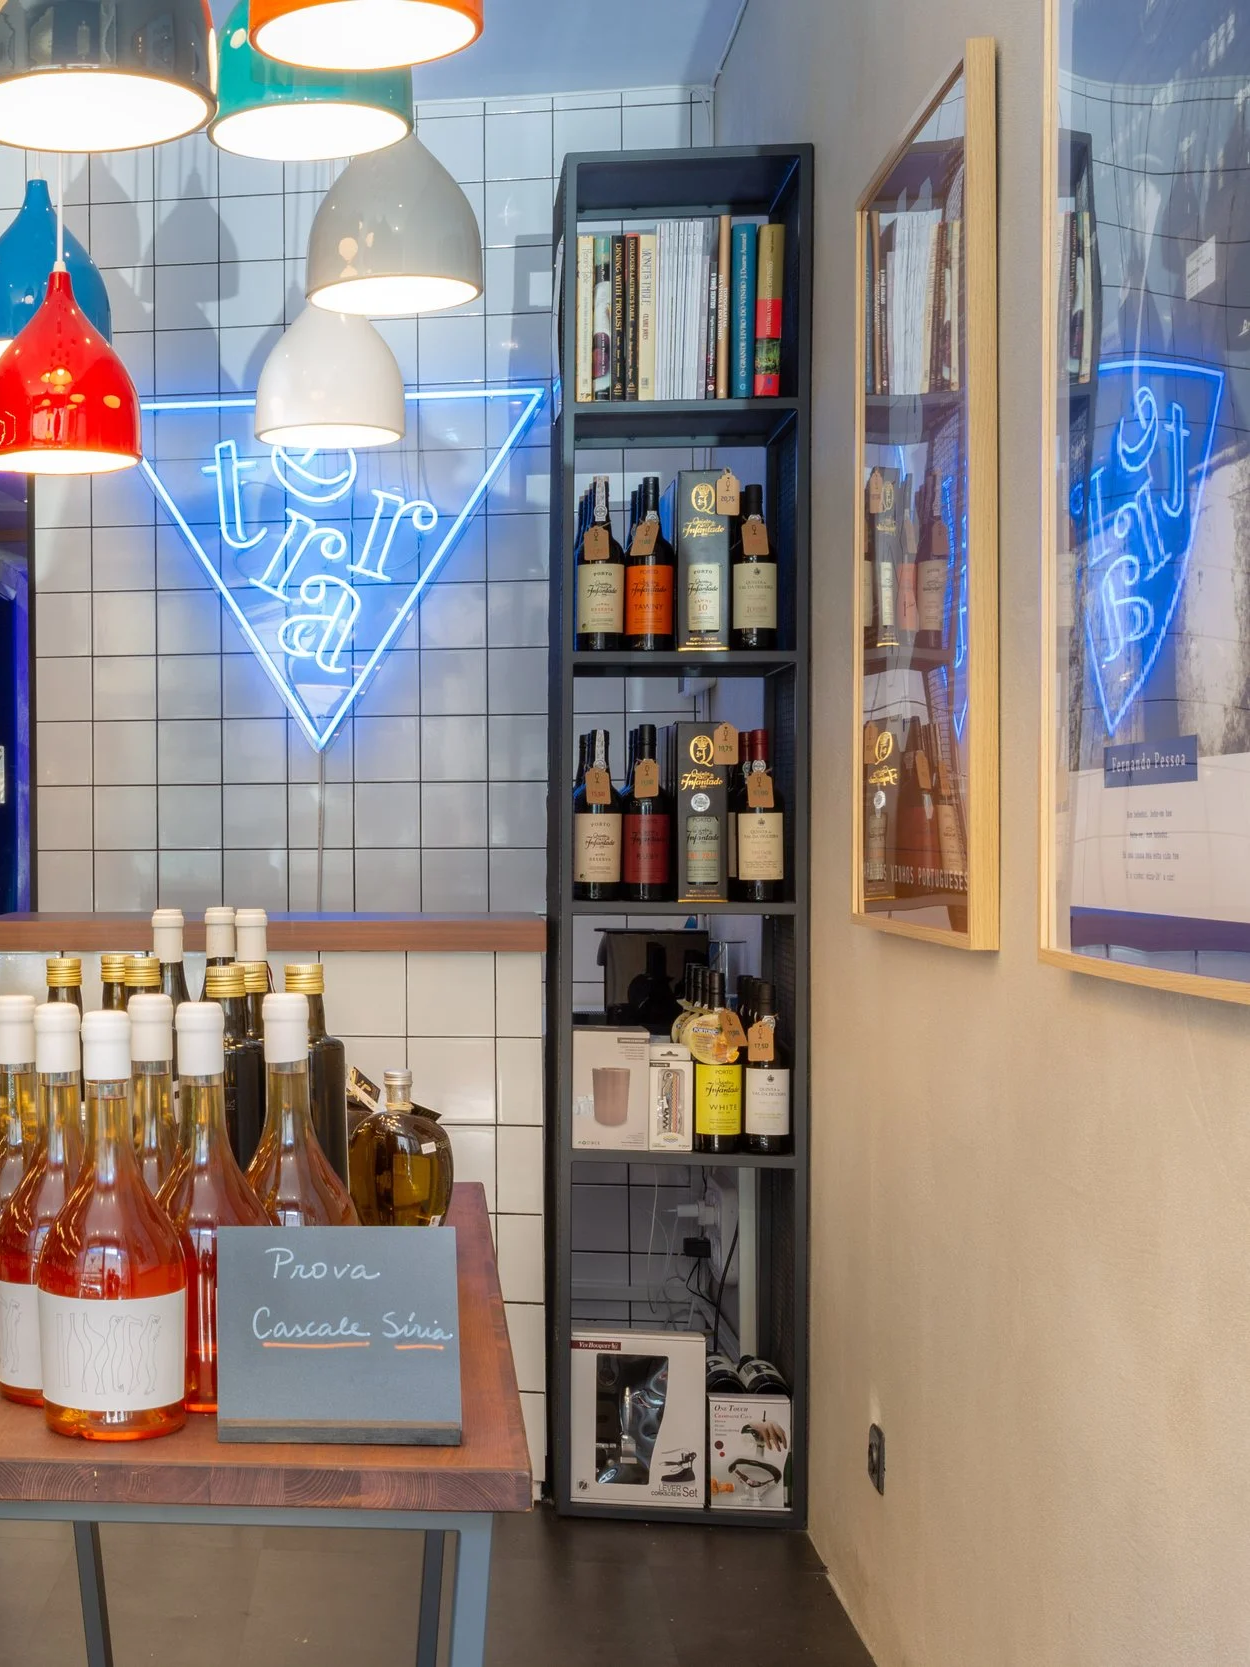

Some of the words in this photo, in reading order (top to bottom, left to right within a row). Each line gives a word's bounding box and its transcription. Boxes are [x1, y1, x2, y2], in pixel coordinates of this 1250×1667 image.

[615, 297, 623, 332] PROUST
[1112, 752, 1151, 773] Fernando
[1154, 752, 1186, 769] Pessoa
[917, 866, 968, 891] PORTUGUESES
[264, 1247, 380, 1281] Prova
[382, 1311, 454, 1341] Síria
[658, 1484, 681, 1492] LEVER
[683, 1487, 698, 1498] Set
